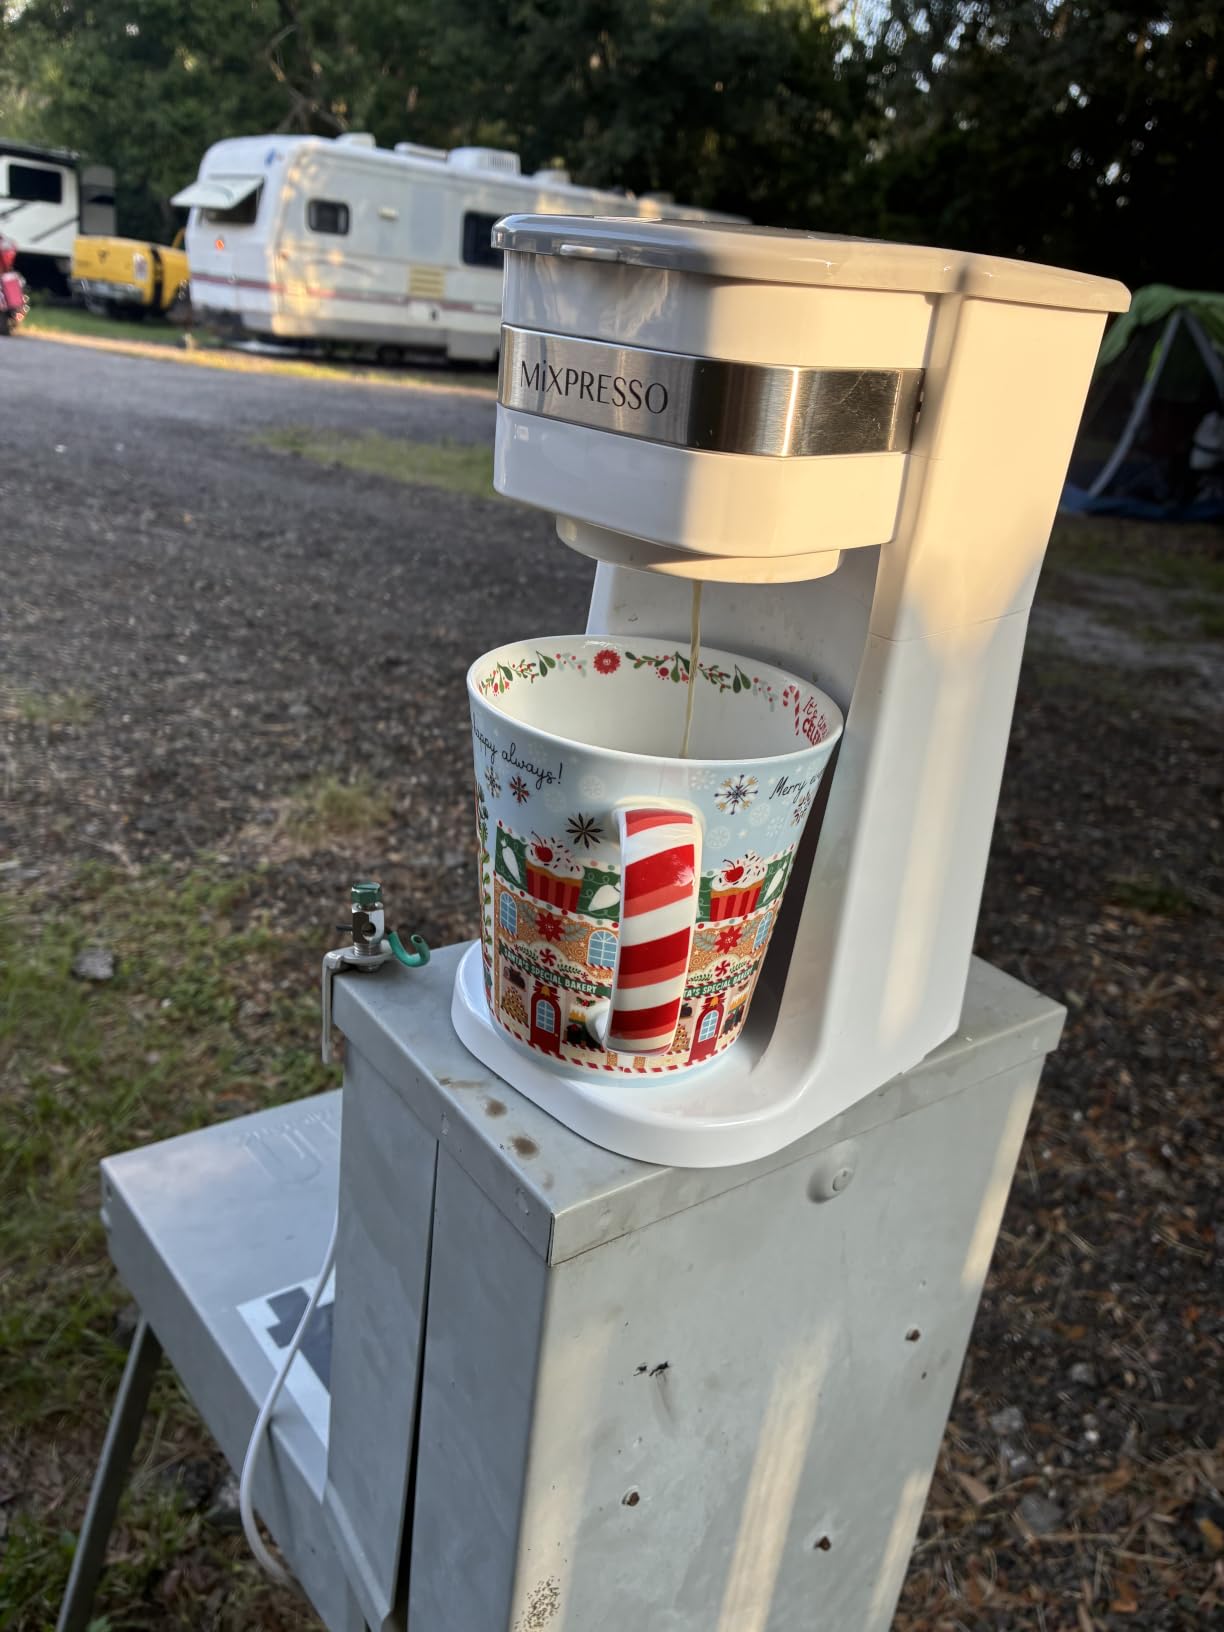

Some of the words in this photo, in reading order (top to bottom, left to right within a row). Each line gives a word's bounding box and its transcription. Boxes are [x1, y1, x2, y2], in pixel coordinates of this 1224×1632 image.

[501, 741, 564, 791] always!
[768, 775, 808, 804] Merry
[504, 948, 530, 971] SANTA'S
[530, 966, 562, 986] SPECIAL
[564, 976, 598, 994] BAKERY
[703, 977, 732, 994] SPECIAL
